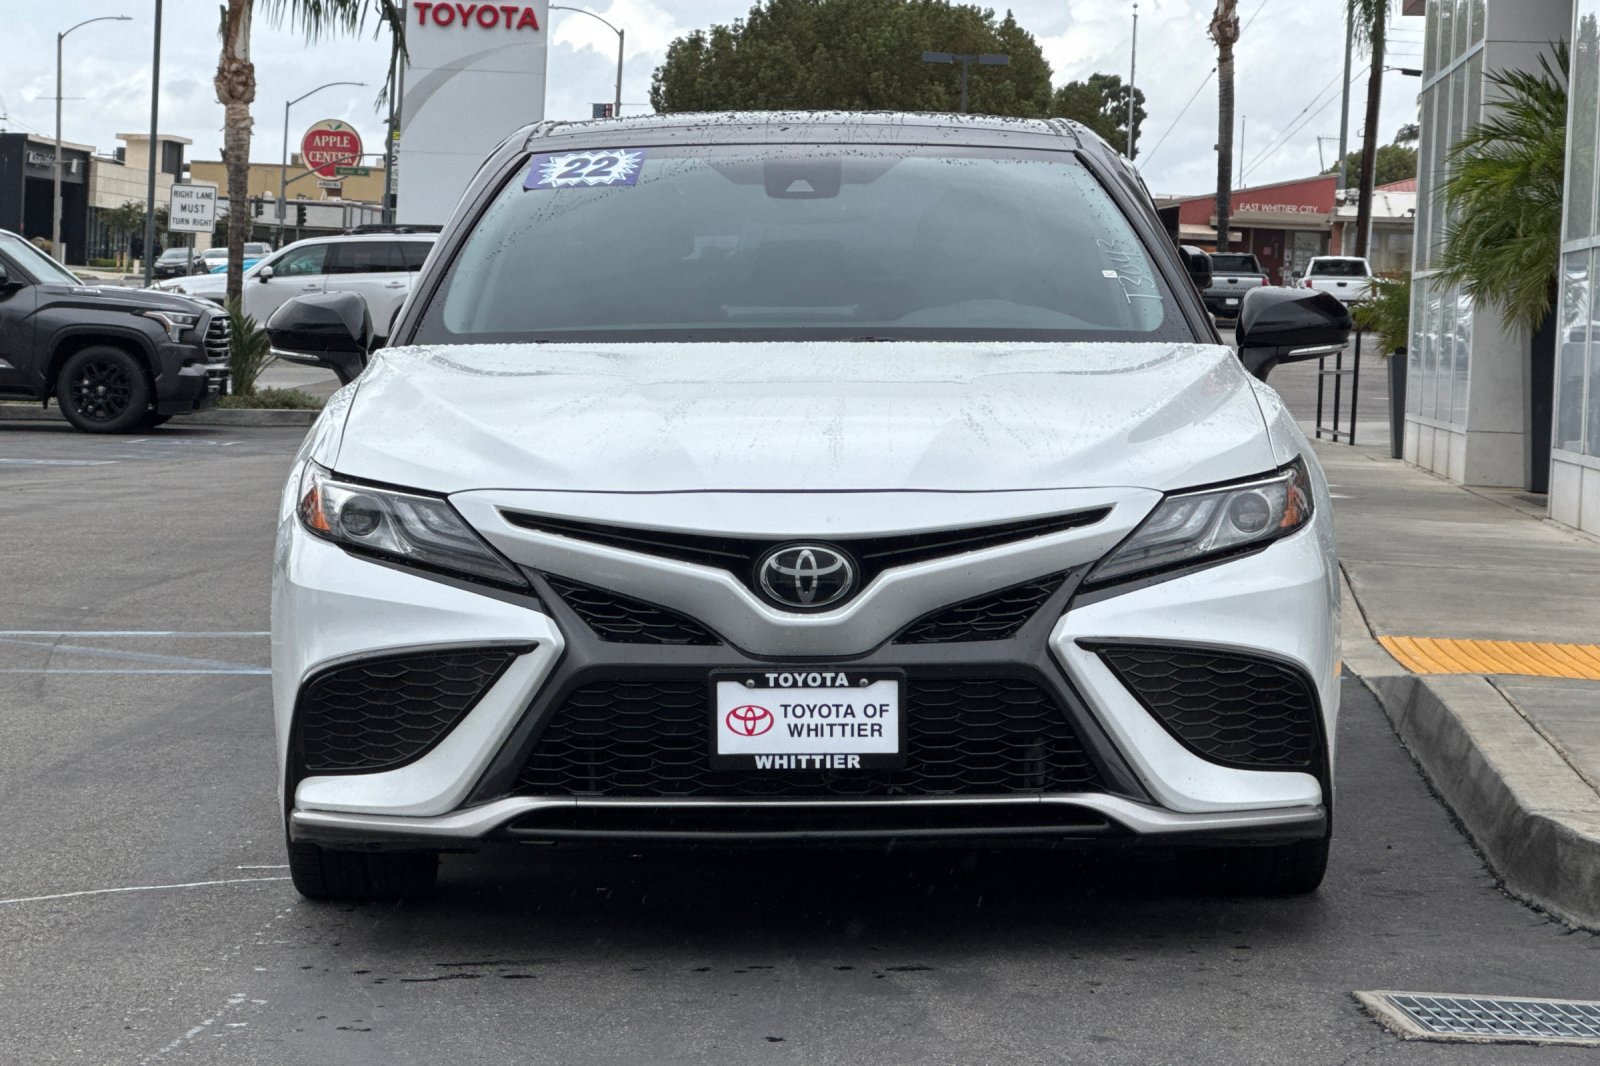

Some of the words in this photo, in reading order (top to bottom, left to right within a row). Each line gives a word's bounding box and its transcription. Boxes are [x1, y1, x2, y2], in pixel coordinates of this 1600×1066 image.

[413, 2, 540, 31] TOYOTA
[313, 136, 351, 148] APPLE
[309, 151, 353, 164] CENTER
[556, 156, 620, 179] 22
[173, 190, 194, 199] RIGHT
[196, 191, 214, 200] LANE
[180, 203, 205, 214] MUST
[1240, 202, 1260, 212] EAST
[1262, 203, 1298, 214] WHITTIER
[1299, 205, 1318, 214] CITY
[172, 217, 190, 225] TURN
[192, 218, 213, 227] RIGHT
[765, 673, 849, 687] TOYOTA
[780, 704, 856, 719] TOYOTA
[863, 704, 890, 719] OF
[787, 723, 883, 738] WHITTIER
[755, 755, 861, 769] WHITTIER
